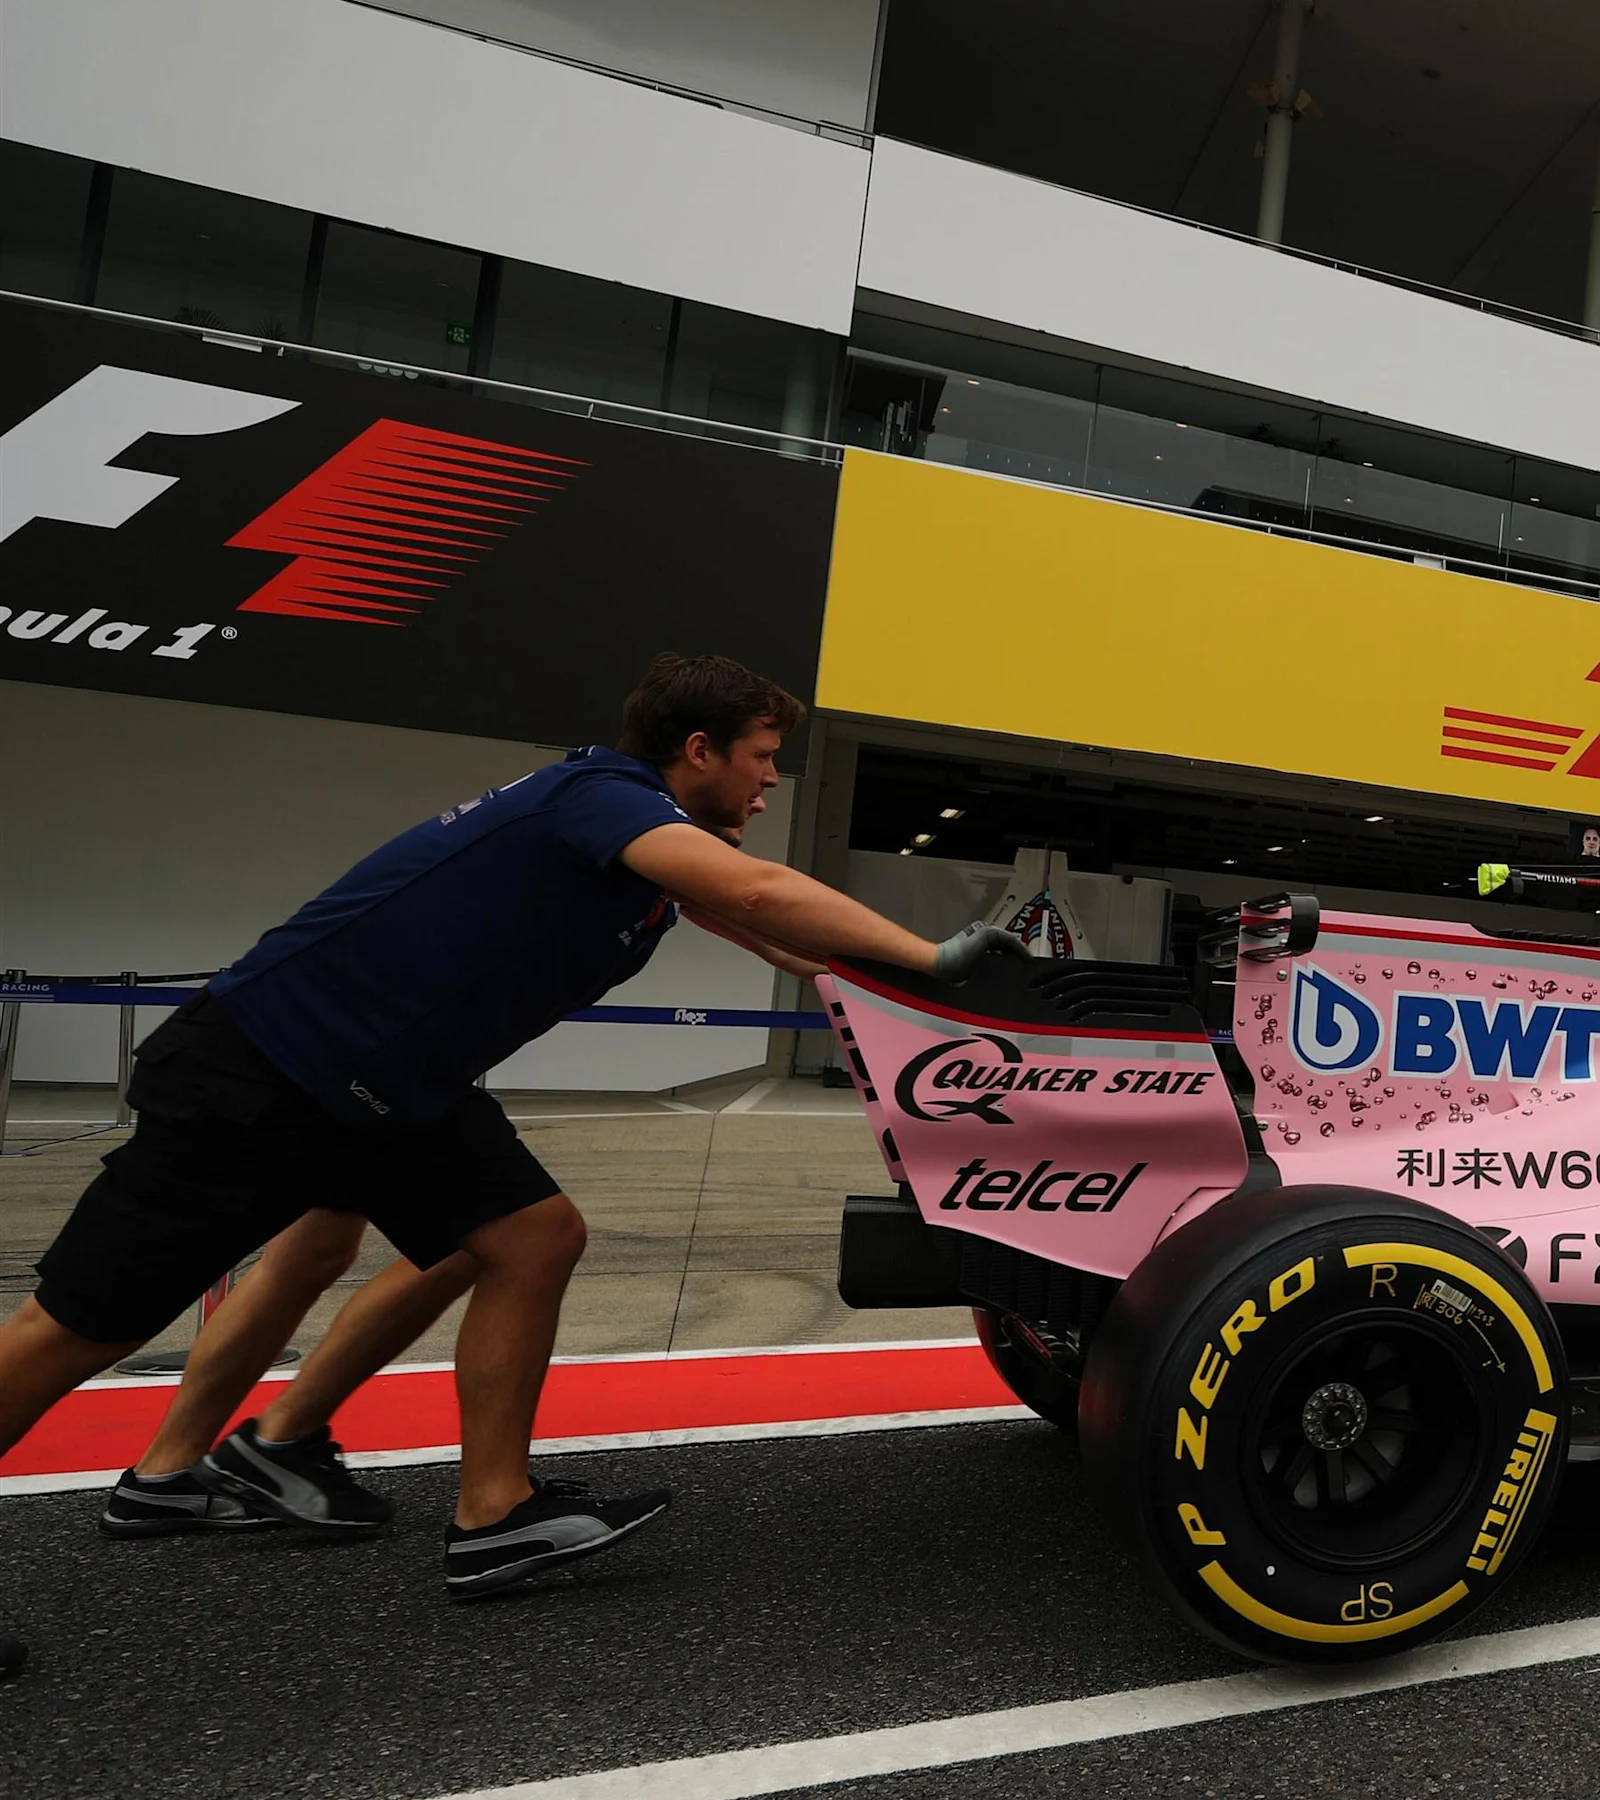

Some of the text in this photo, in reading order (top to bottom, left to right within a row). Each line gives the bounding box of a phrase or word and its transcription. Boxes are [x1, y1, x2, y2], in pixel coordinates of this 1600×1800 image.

[1536, 873, 1577, 885] WILLIAMS
[2, 983, 50, 992] RACING
[932, 1059, 1215, 1095] QUAKER STATE
[939, 1158, 1149, 1213] telcel
[1369, 1264, 1399, 1298] R
[1174, 1256, 1317, 1546] P ZERO
[1466, 1408, 1558, 1577] PIRELLI
